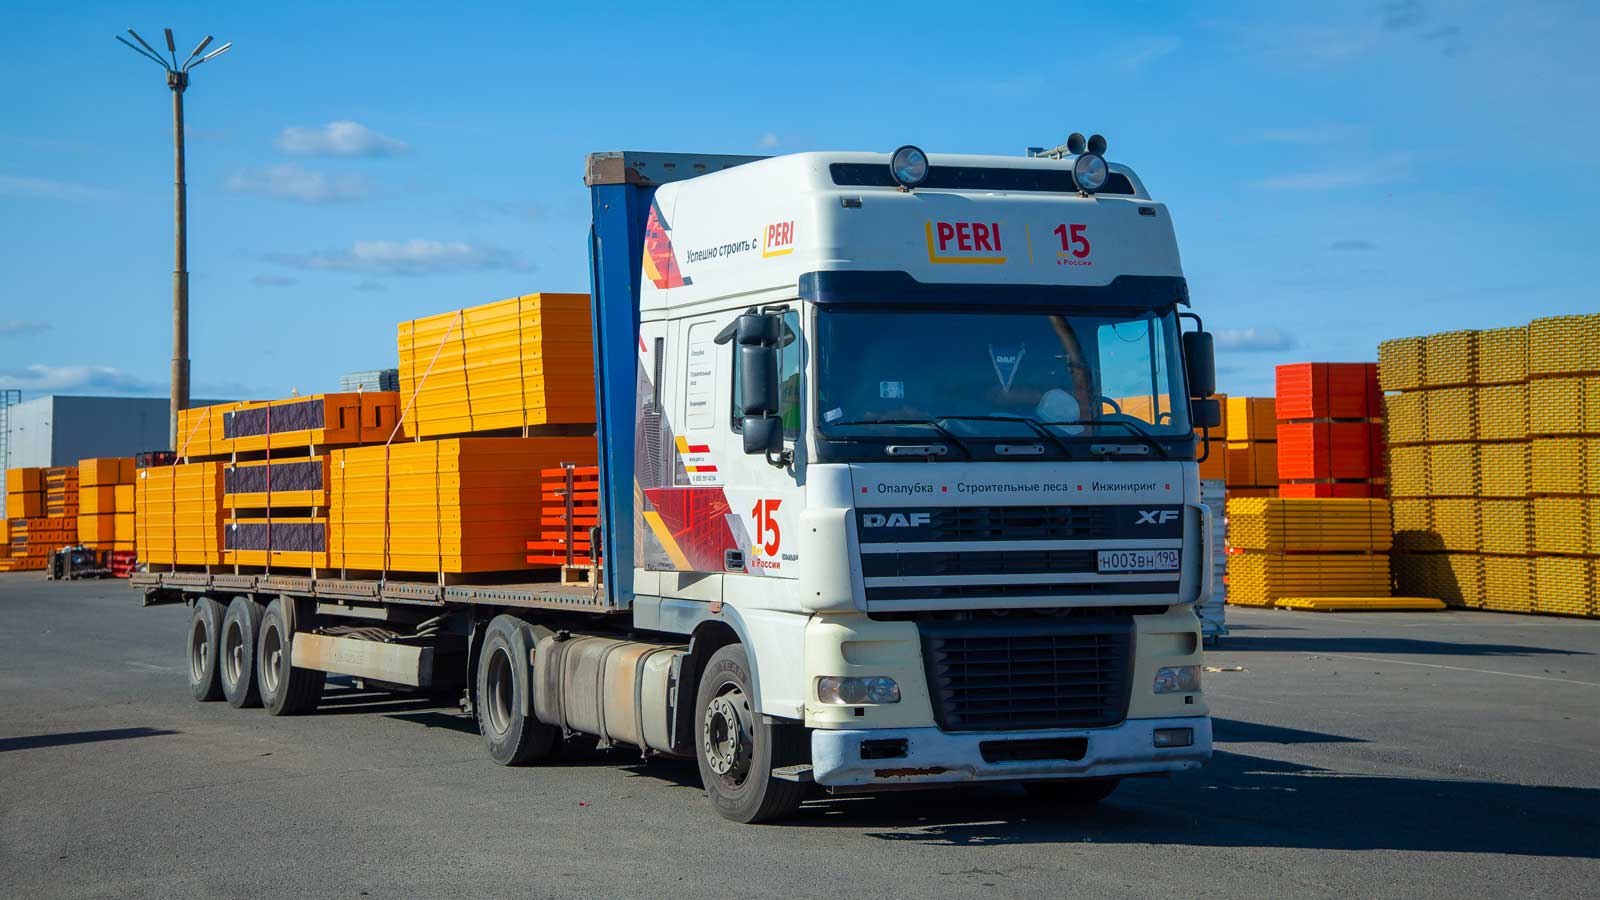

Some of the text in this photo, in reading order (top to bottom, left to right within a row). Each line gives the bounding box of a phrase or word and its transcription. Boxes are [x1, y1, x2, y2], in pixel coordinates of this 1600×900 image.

[767, 221, 794, 248] PERI
[936, 221, 1002, 252] PERI
[1053, 223, 1091, 259] 15
[686, 238, 757, 264] Успешно строить с
[1063, 258, 1093, 267] России
[877, 481, 934, 495] Опалубка
[956, 481, 1068, 494] Строительные леса
[1091, 480, 1158, 493] Инжиниринг
[862, 512, 931, 528] DAF
[1135, 509, 1180, 525] XF
[751, 498, 783, 557] 15
[756, 558, 781, 569] России
